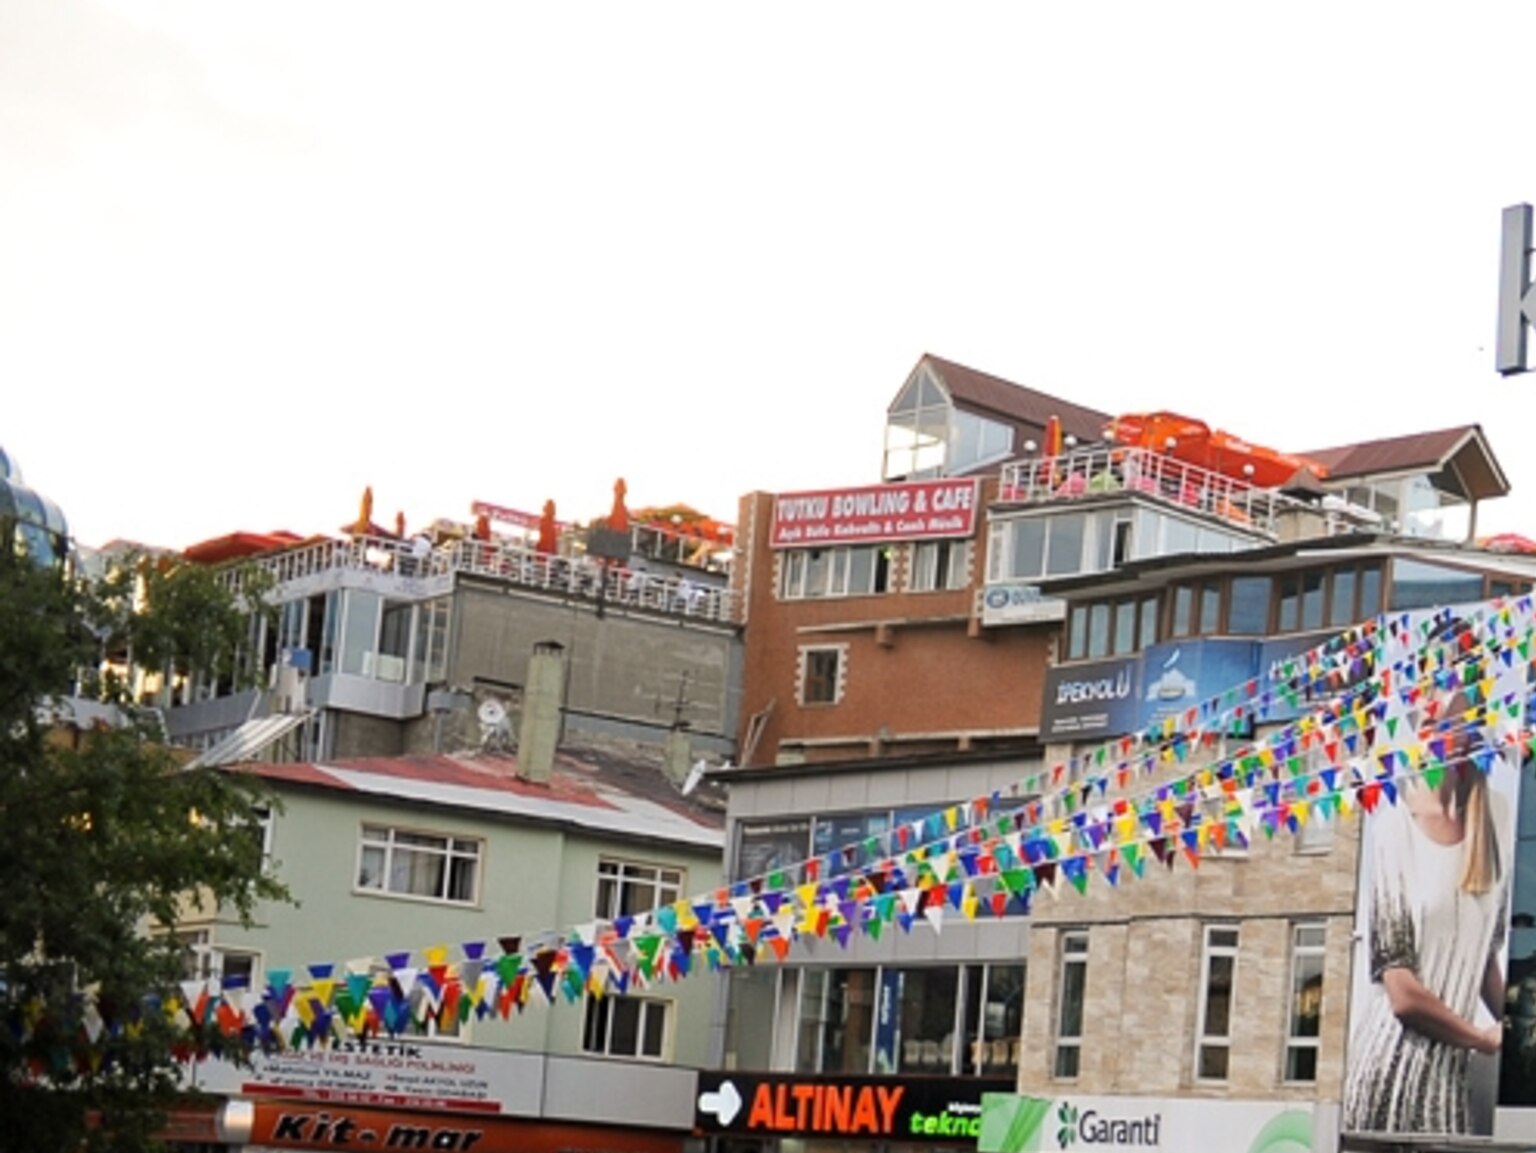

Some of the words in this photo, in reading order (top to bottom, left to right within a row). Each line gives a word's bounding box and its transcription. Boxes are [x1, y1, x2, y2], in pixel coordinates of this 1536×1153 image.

[778, 496, 829, 521] TUTKU
[831, 490, 910, 518] BOWLING
[913, 489, 926, 513] &
[932, 486, 973, 511] CAFE
[747, 1082, 906, 1134] ALTINAY
[1079, 1108, 1162, 1147] Garanti
